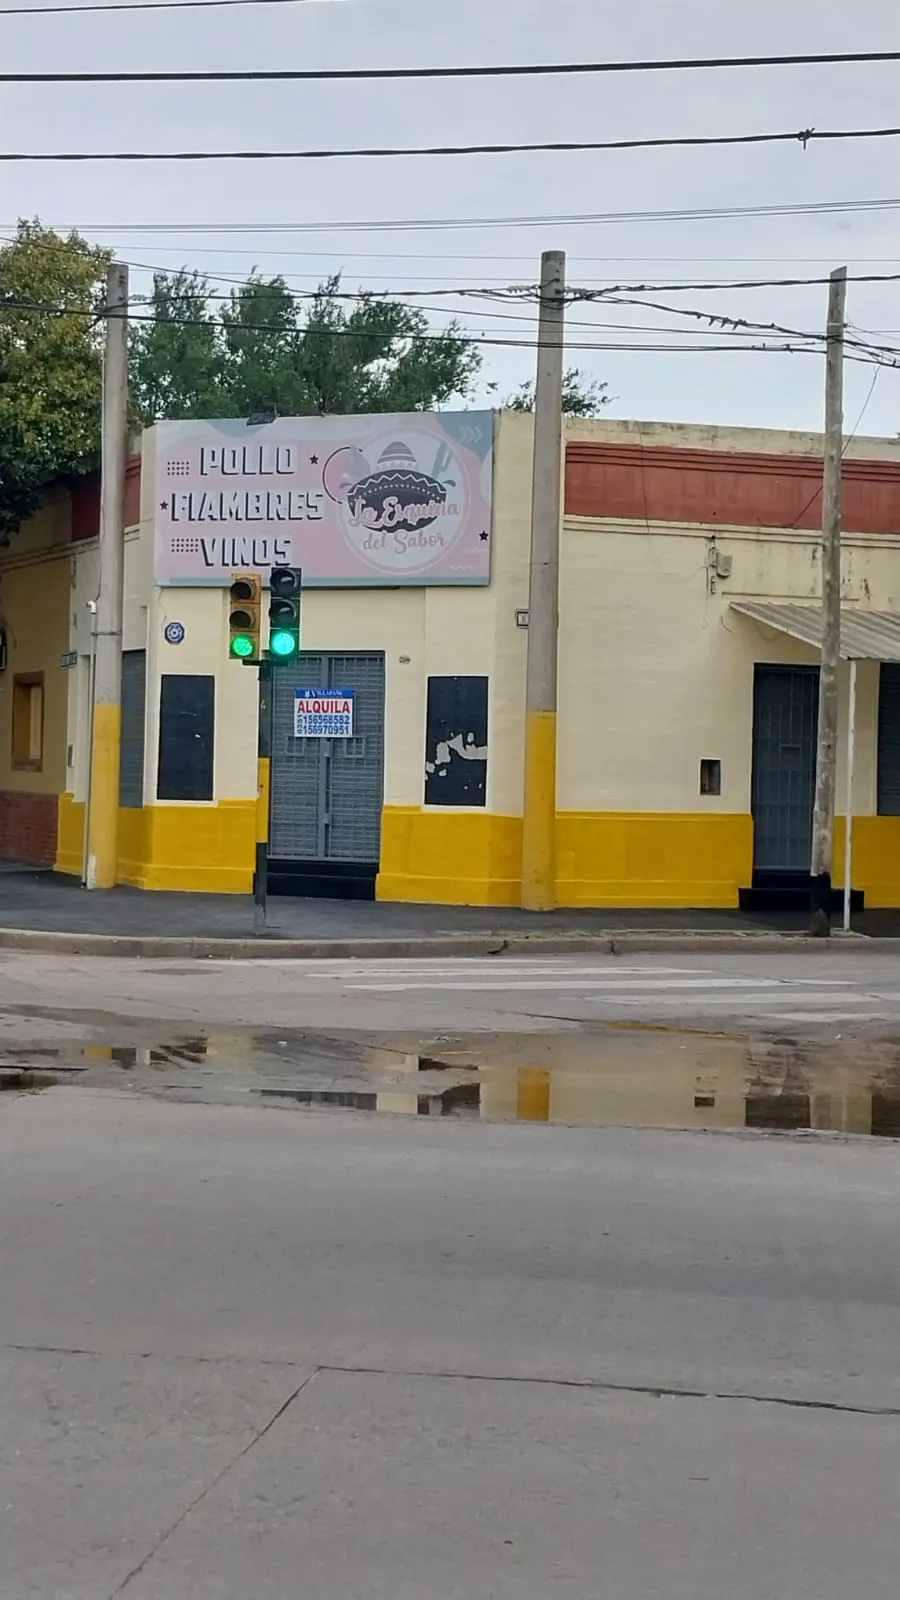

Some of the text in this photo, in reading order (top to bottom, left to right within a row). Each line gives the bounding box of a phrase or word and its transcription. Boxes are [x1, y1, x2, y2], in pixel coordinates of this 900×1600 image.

[200, 445, 297, 476] POLLO
[171, 491, 324, 521] FIAMBRES
[348, 494, 460, 527] La Esquina
[198, 538, 292, 567] VINOS
[363, 530, 446, 554] del Sabor
[297, 700, 350, 713] ALQUILA
[303, 725, 349, 735] 156970951
